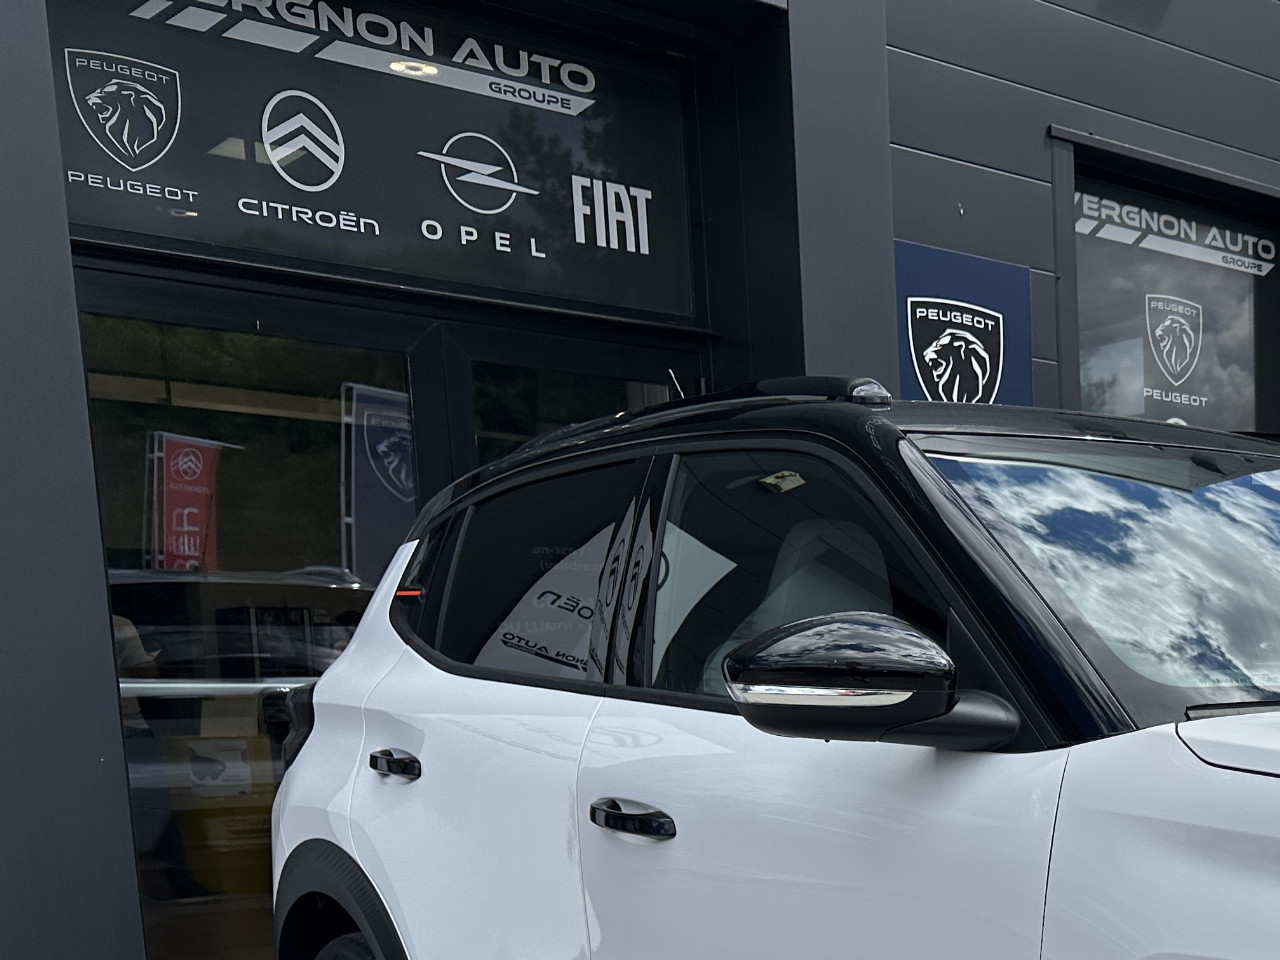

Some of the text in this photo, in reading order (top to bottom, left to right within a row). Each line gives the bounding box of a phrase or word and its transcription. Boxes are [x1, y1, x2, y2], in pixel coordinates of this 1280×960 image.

[75, 57, 171, 85] PEUGEOT
[452, 38, 595, 93] AUTO
[488, 81, 573, 111] GROUPE
[67, 170, 199, 203] PEUGEOT
[570, 174, 652, 255] FIAT
[420, 219, 546, 258] OPEL
[1205, 226, 1276, 260] AUTO
[1221, 255, 1264, 273] GROUPE
[916, 307, 995, 331] PEUGEOT
[1150, 300, 1198, 317] PEUGEOT
[1143, 387, 1208, 407] PEUGEOT
